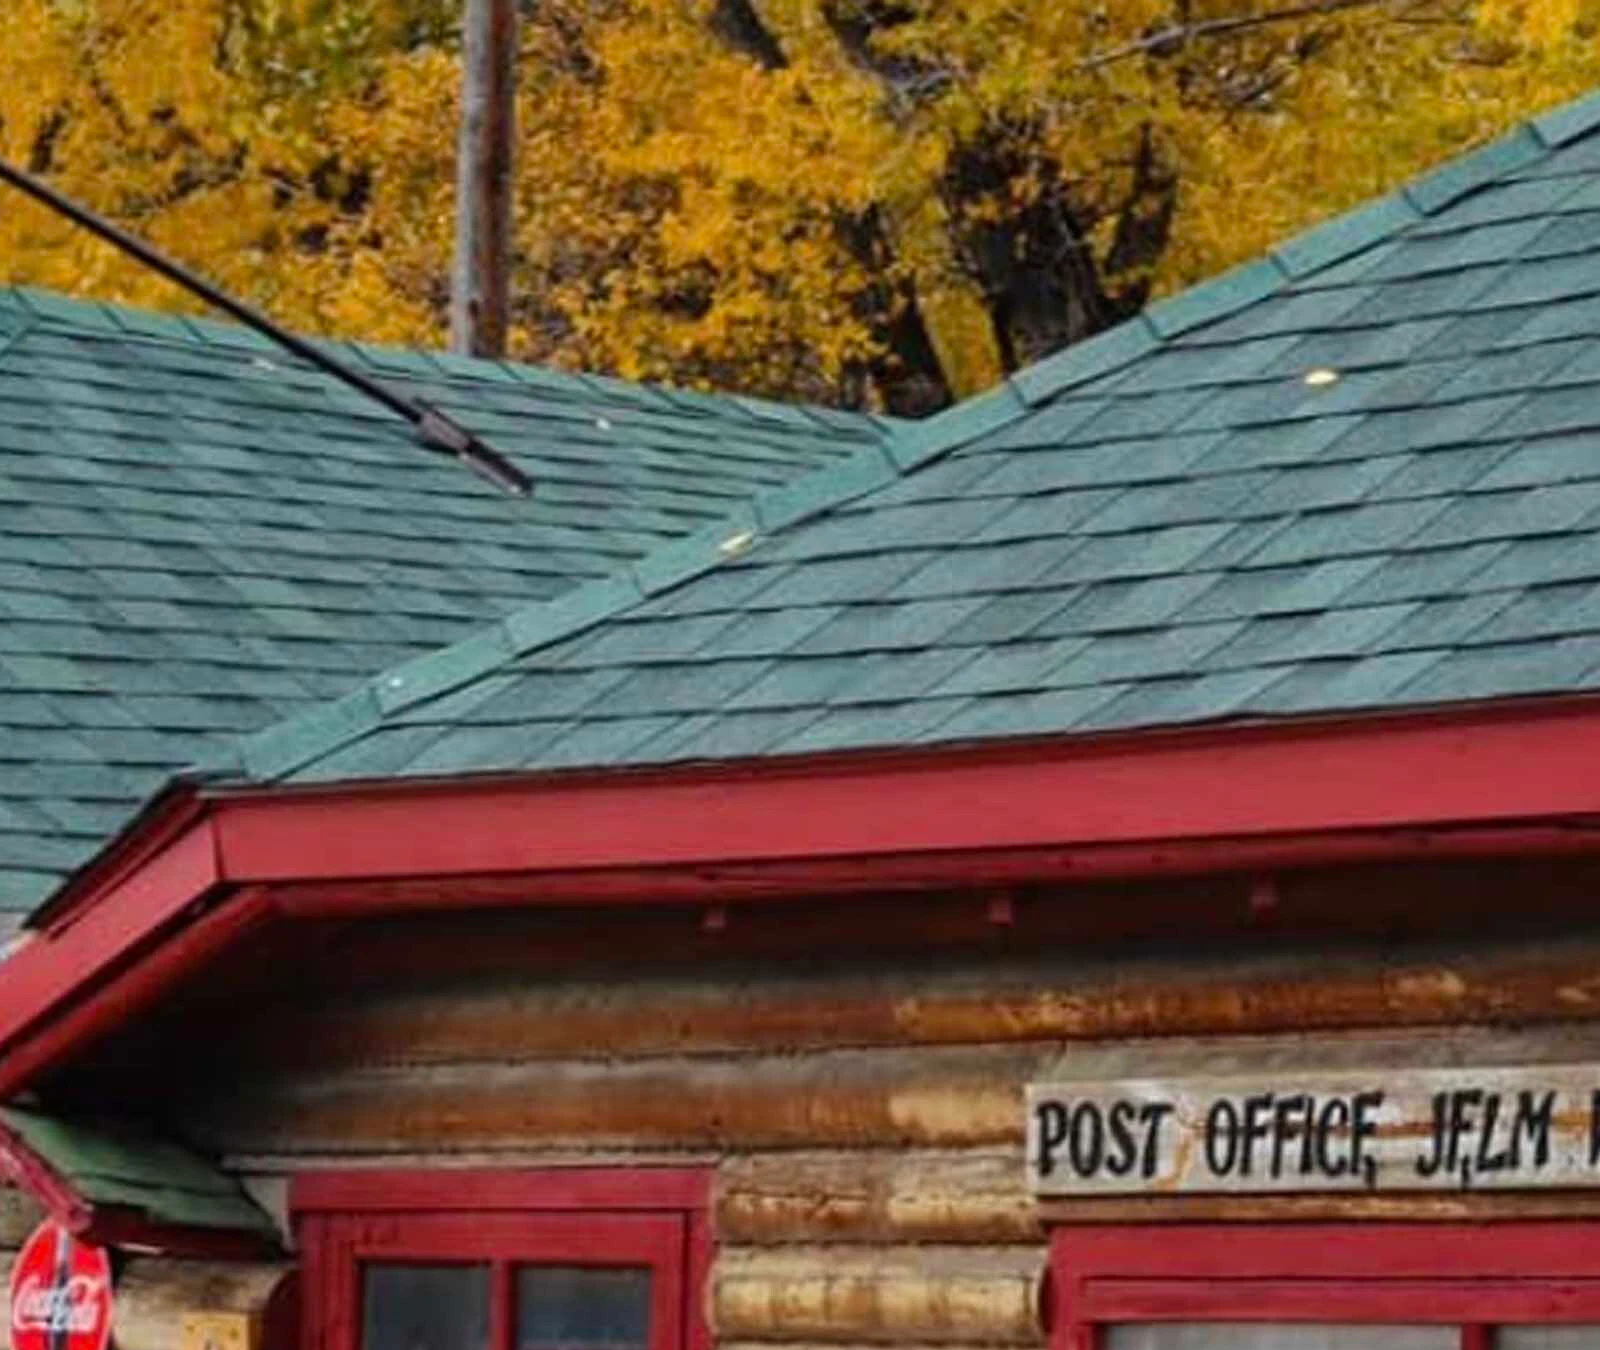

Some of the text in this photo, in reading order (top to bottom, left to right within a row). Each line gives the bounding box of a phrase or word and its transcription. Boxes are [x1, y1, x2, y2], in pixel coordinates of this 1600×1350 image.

[1036, 1097, 1176, 1179] POST
[1205, 1089, 1385, 1191] OFFICE
[1415, 1088, 1557, 1191] JELM
